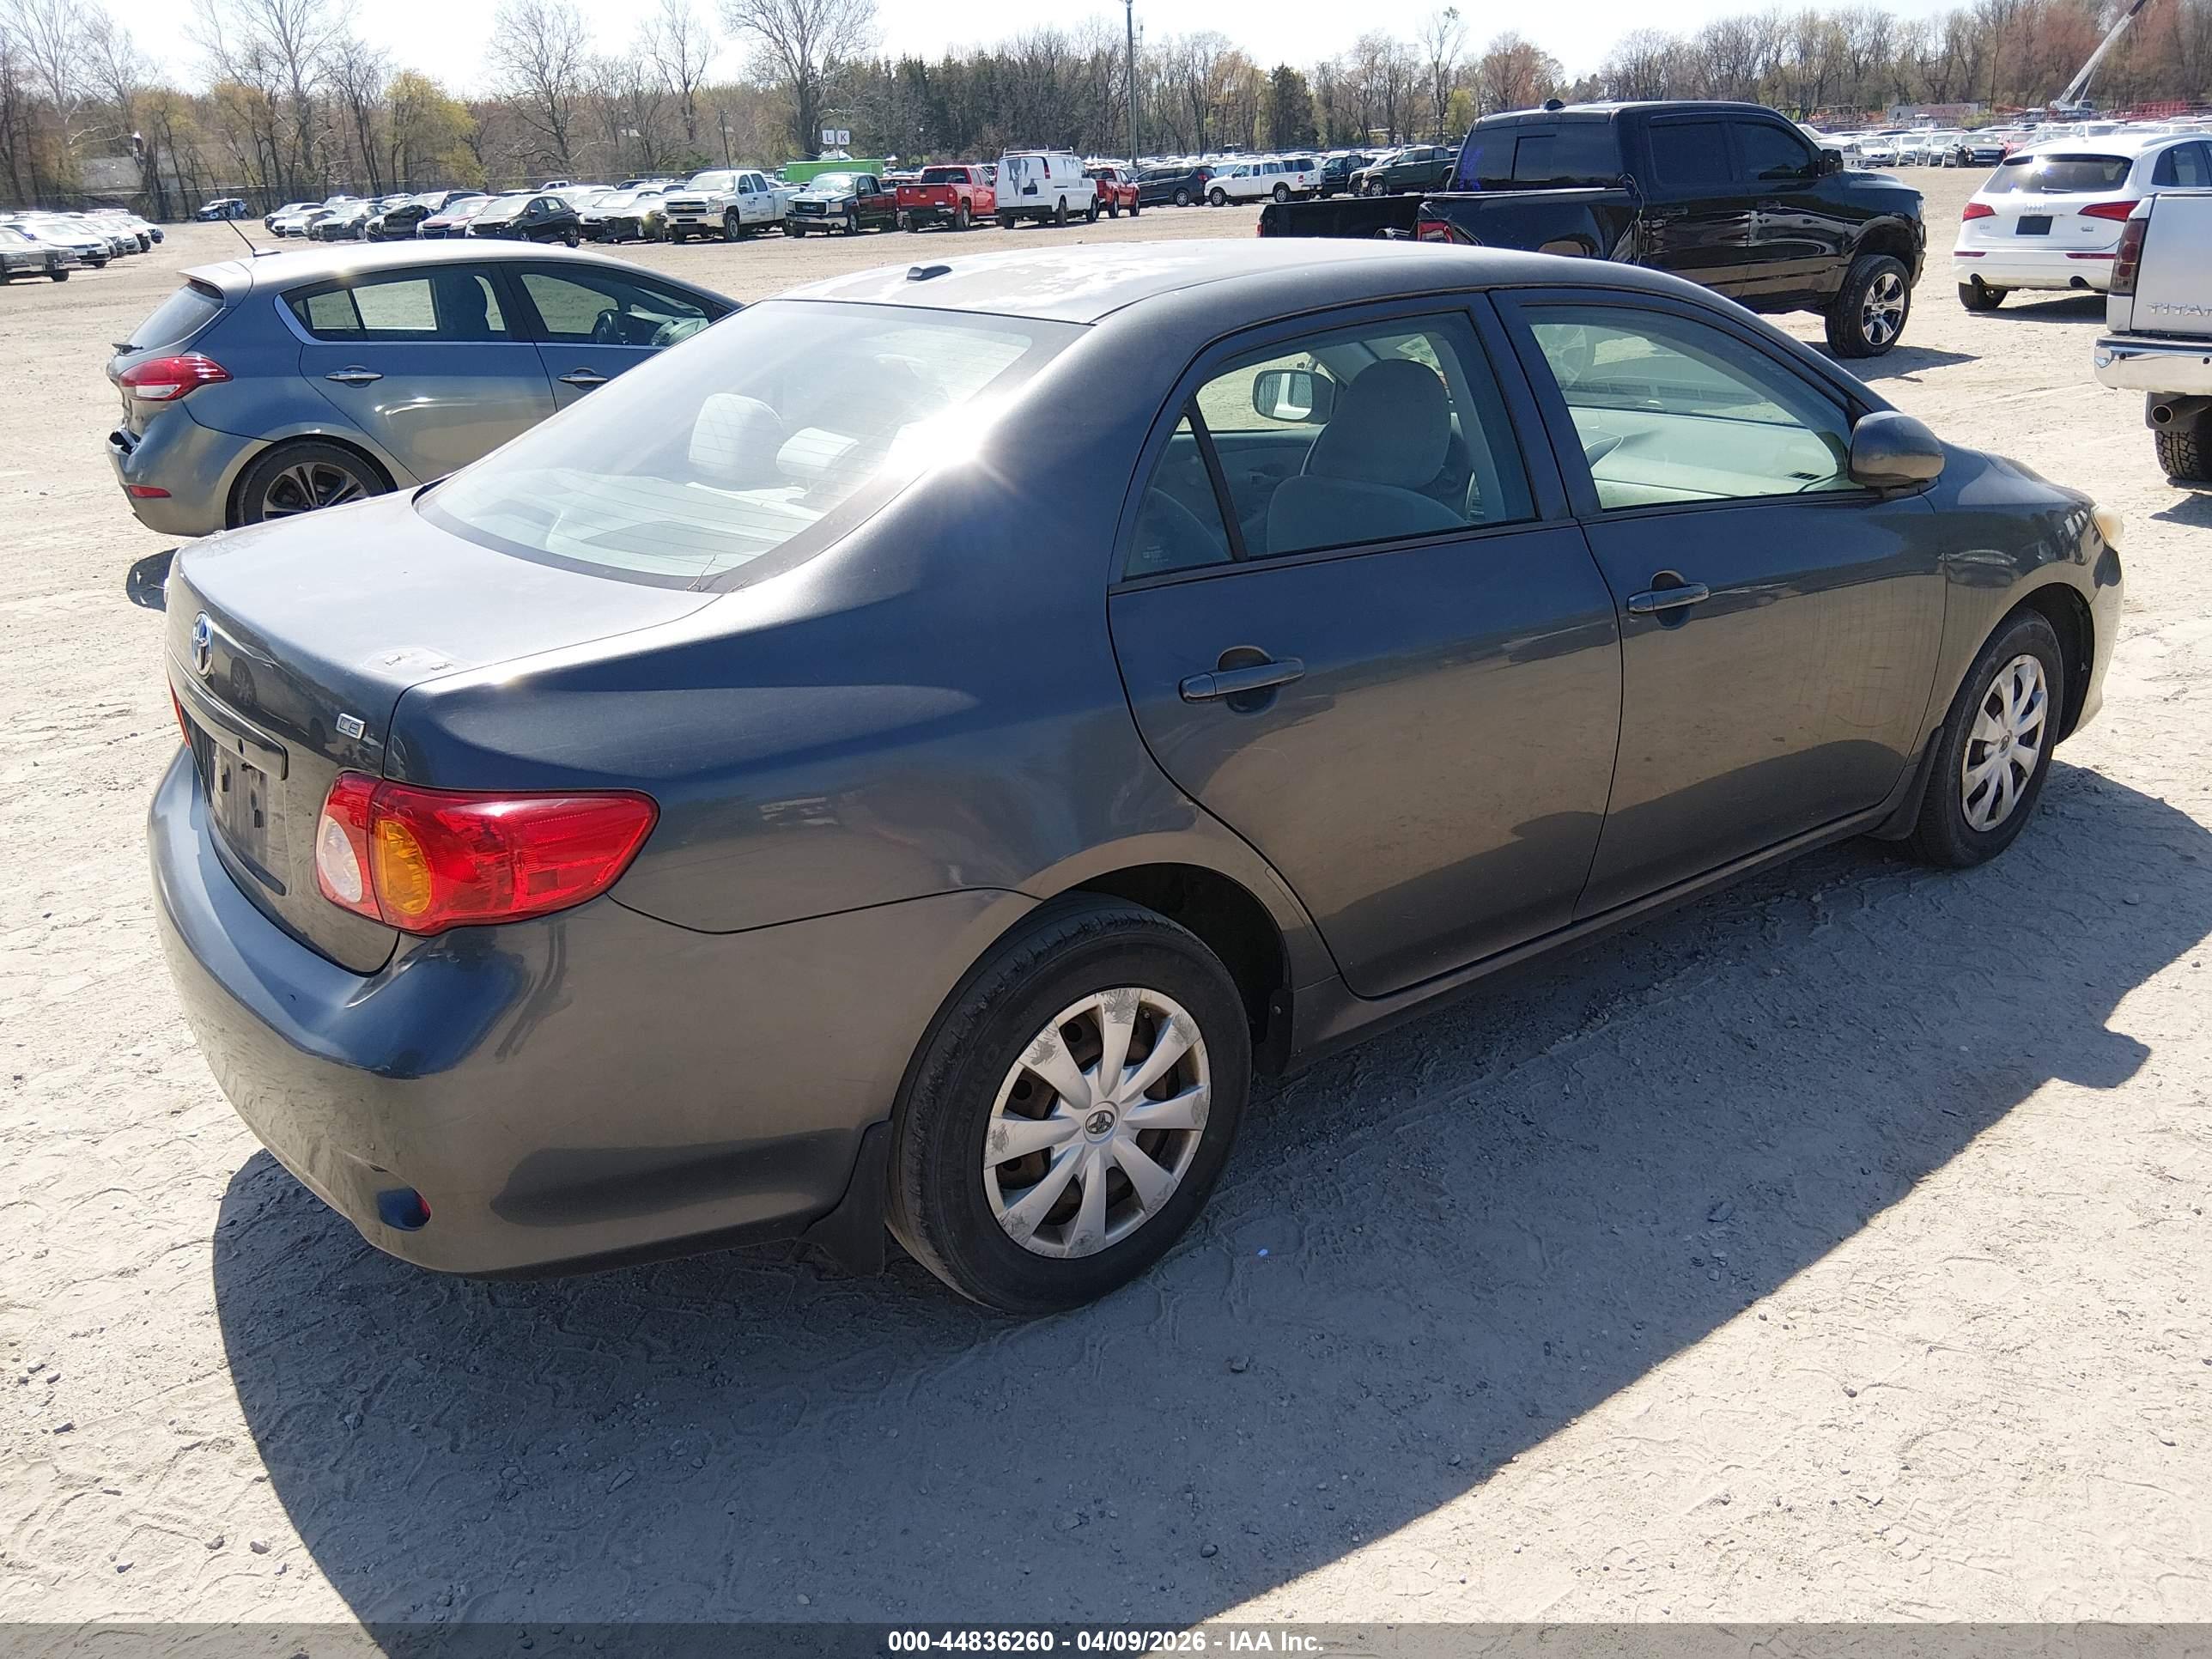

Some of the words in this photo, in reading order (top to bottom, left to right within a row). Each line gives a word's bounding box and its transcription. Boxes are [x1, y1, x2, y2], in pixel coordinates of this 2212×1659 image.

[826, 132, 832, 143] L
[840, 132, 847, 143] K
[339, 716, 360, 737] LE
